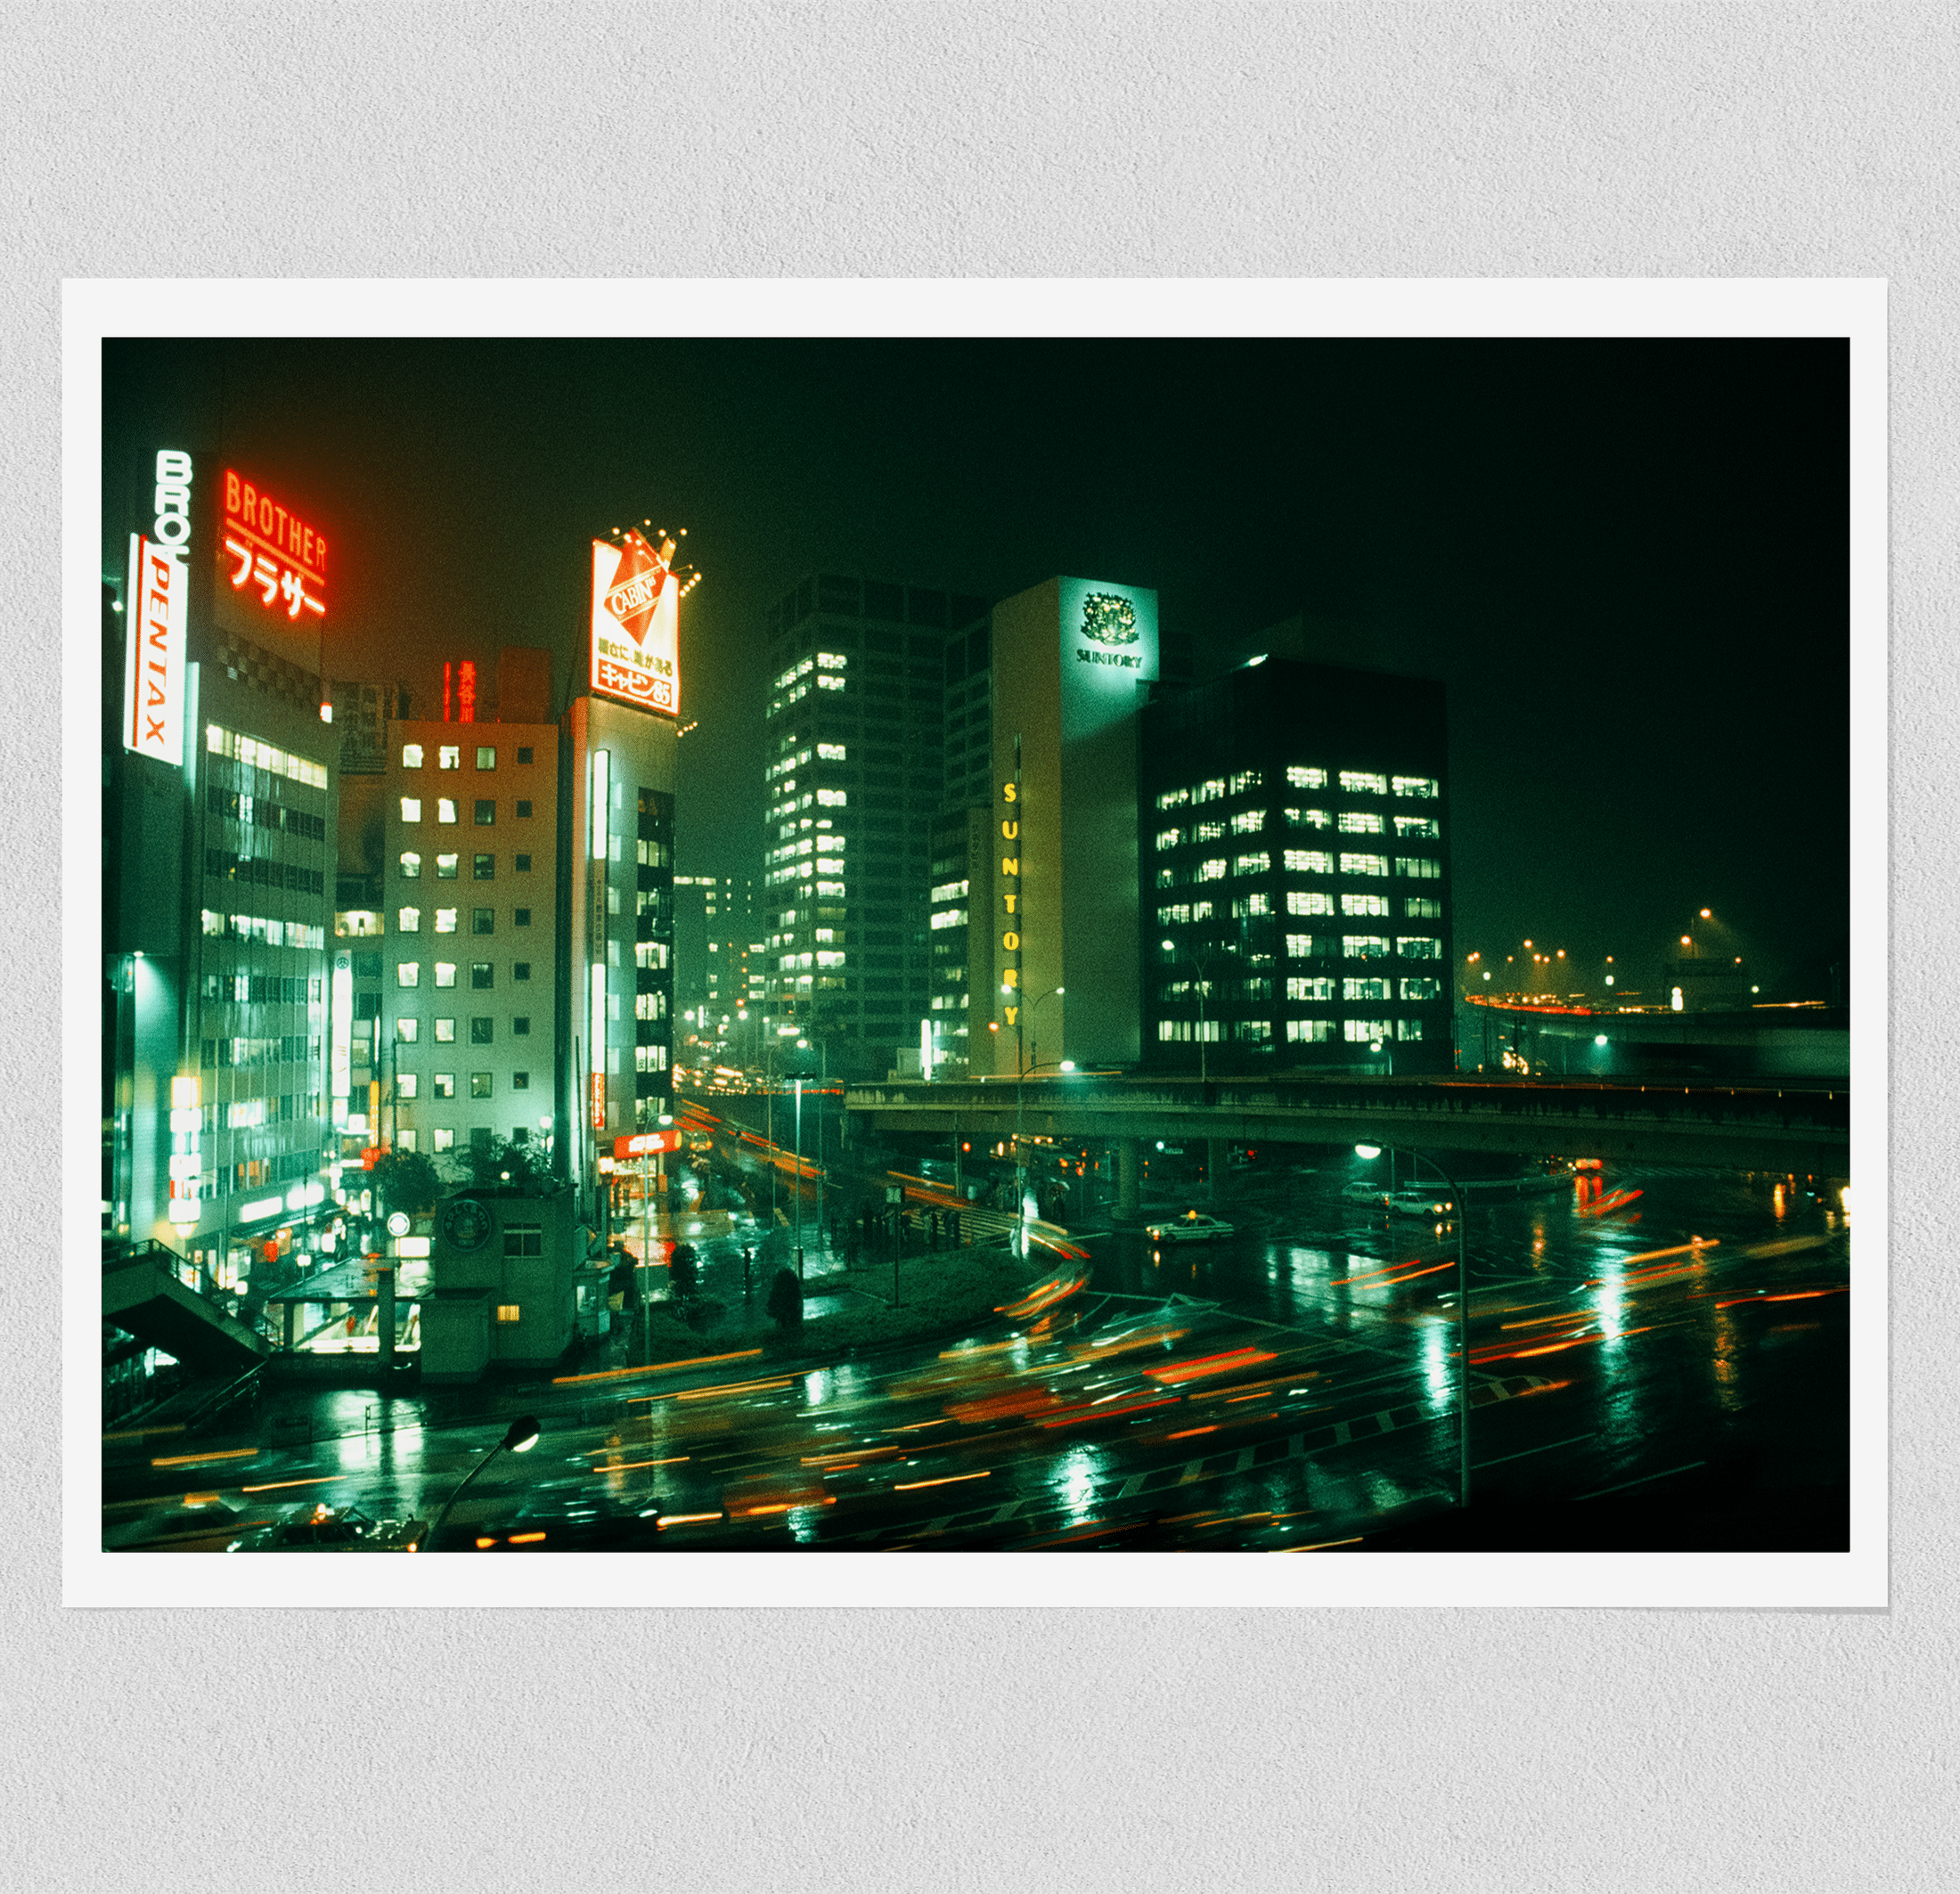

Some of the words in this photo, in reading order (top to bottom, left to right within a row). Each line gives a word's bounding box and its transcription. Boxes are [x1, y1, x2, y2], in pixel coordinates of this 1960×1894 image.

[225, 469, 327, 573] BROTHER
[611, 579, 653, 615] CABIN
[145, 554, 170, 746] PENTAX
[1076, 649, 1143, 668] SUNTORY
[1002, 783, 1019, 1025] SUNTORY
